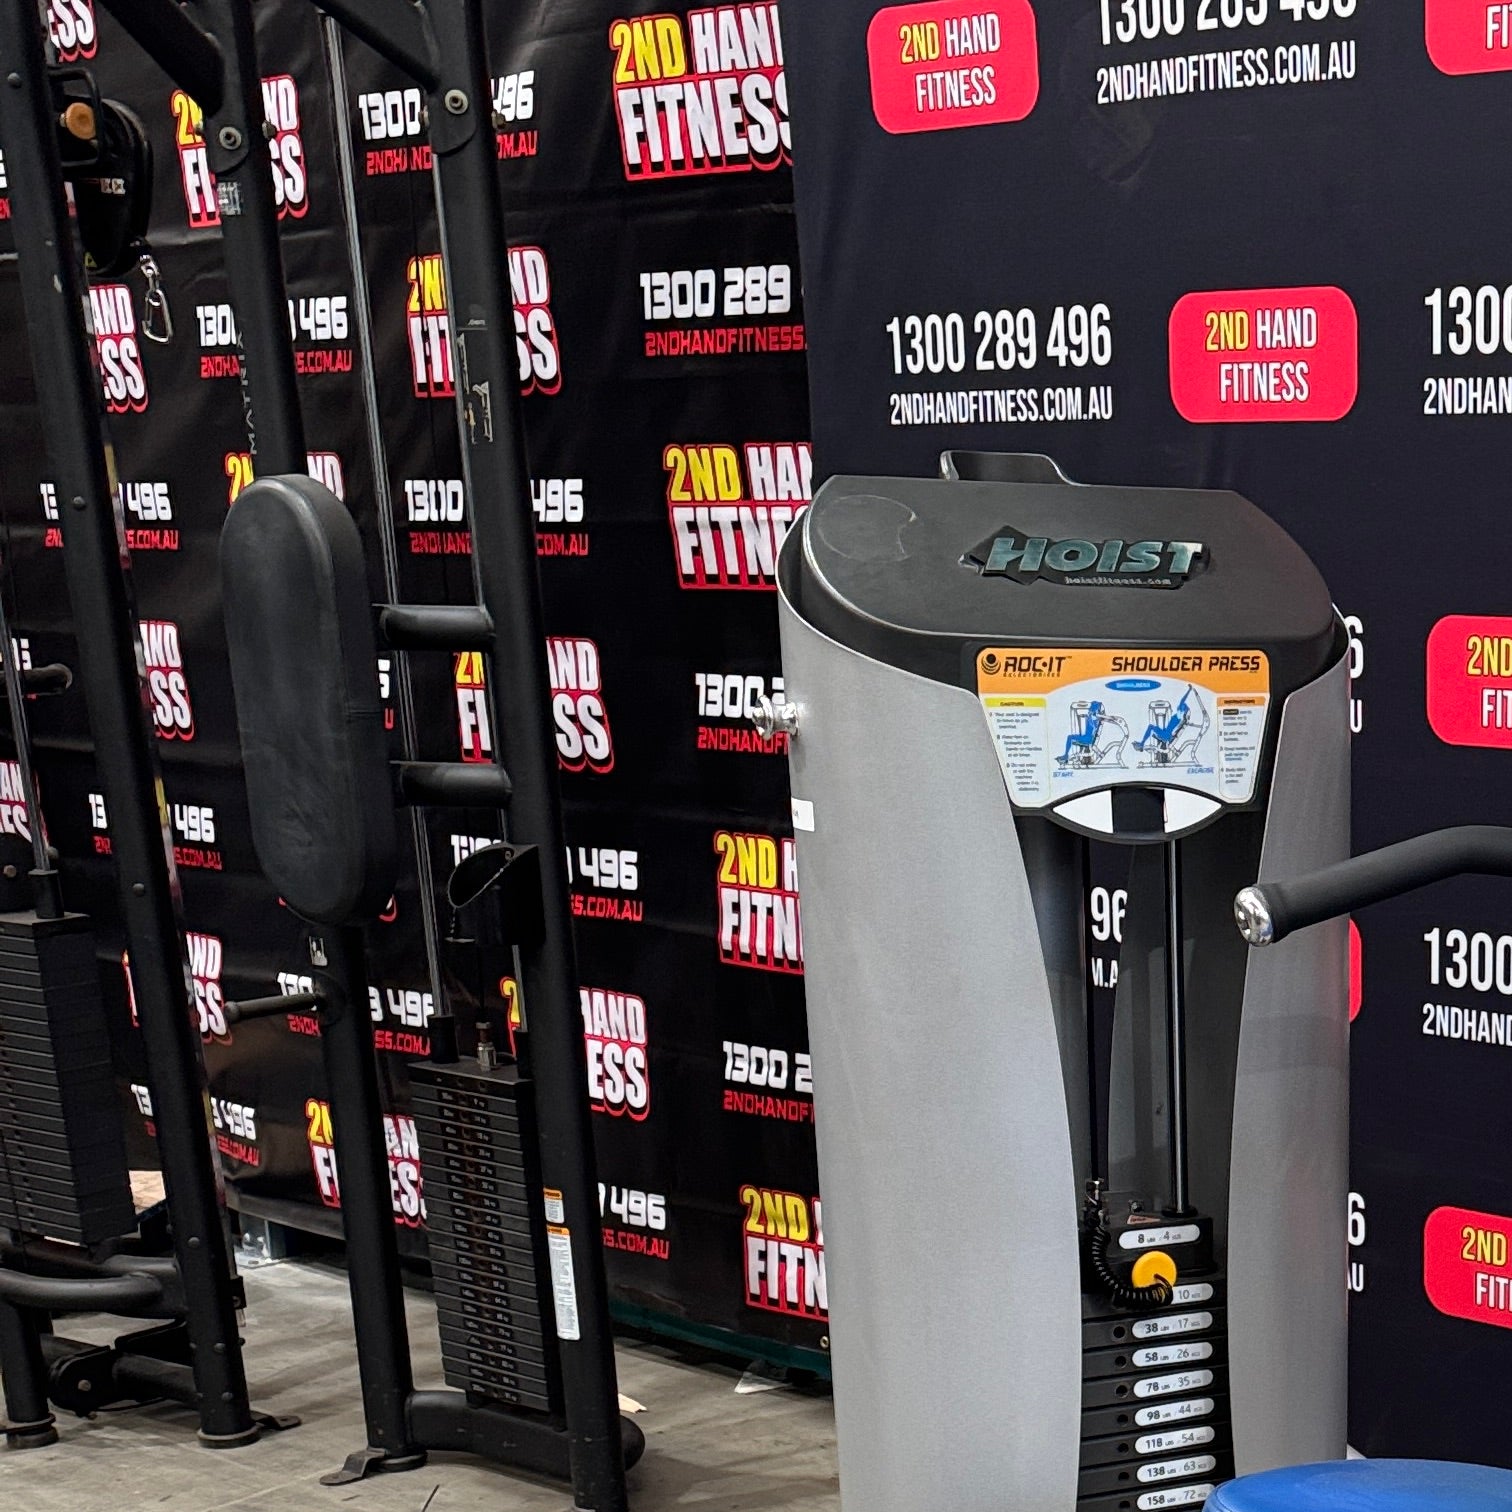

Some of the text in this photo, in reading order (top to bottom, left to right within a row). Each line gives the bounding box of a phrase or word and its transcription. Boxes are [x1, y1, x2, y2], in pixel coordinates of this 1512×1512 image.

[612, 4, 784, 84] 2ND HAN
[899, 13, 1001, 64] 2ND HAND
[915, 65, 997, 112] FITNESS
[1096, 39, 1357, 105] 2NDHANDFITNESS.COM.AU
[261, 77, 299, 131] ND
[358, 87, 421, 140] 1300
[639, 264, 791, 320] 1300 289
[299, 295, 348, 341] 496
[886, 303, 1112, 375] 1300 289 496
[1205, 307, 1317, 351] 2ND HAND
[644, 324, 806, 357] 2NDHANDFITNESS.
[1220, 361, 1309, 402] FITNESS
[889, 385, 1113, 426] 2NDHANDFITNESS.COM.AU
[666, 447, 742, 501] 2ND
[126, 482, 173, 521] 496
[529, 478, 584, 523] 496
[985, 537, 1202, 575] HOIST
[1111, 655, 1261, 672] SHOULDER PRESS
[174, 803, 215, 843] 496
[578, 846, 638, 891] 496
[716, 833, 777, 889] 2ND
[720, 887, 801, 961] FITN
[722, 1040, 789, 1090] 1300
[219, 1099, 257, 1141] 496
[610, 1185, 666, 1231] 496
[742, 1187, 810, 1248] 2ND
[1137, 1232, 1146, 1244] 8
[1462, 1226, 1507, 1266] 2ND
[1177, 1289, 1190, 1300] 10
[1144, 1318, 1189, 1334] 38 17
[1144, 1348, 1190, 1363] 58 26
[1145, 1376, 1191, 1393] 78 35
[1146, 1404, 1193, 1421] 98 44
[1145, 1433, 1195, 1450] 118 54
[1146, 1461, 1197, 1478] 138 63
[1146, 1489, 1197, 1506] 158 72
